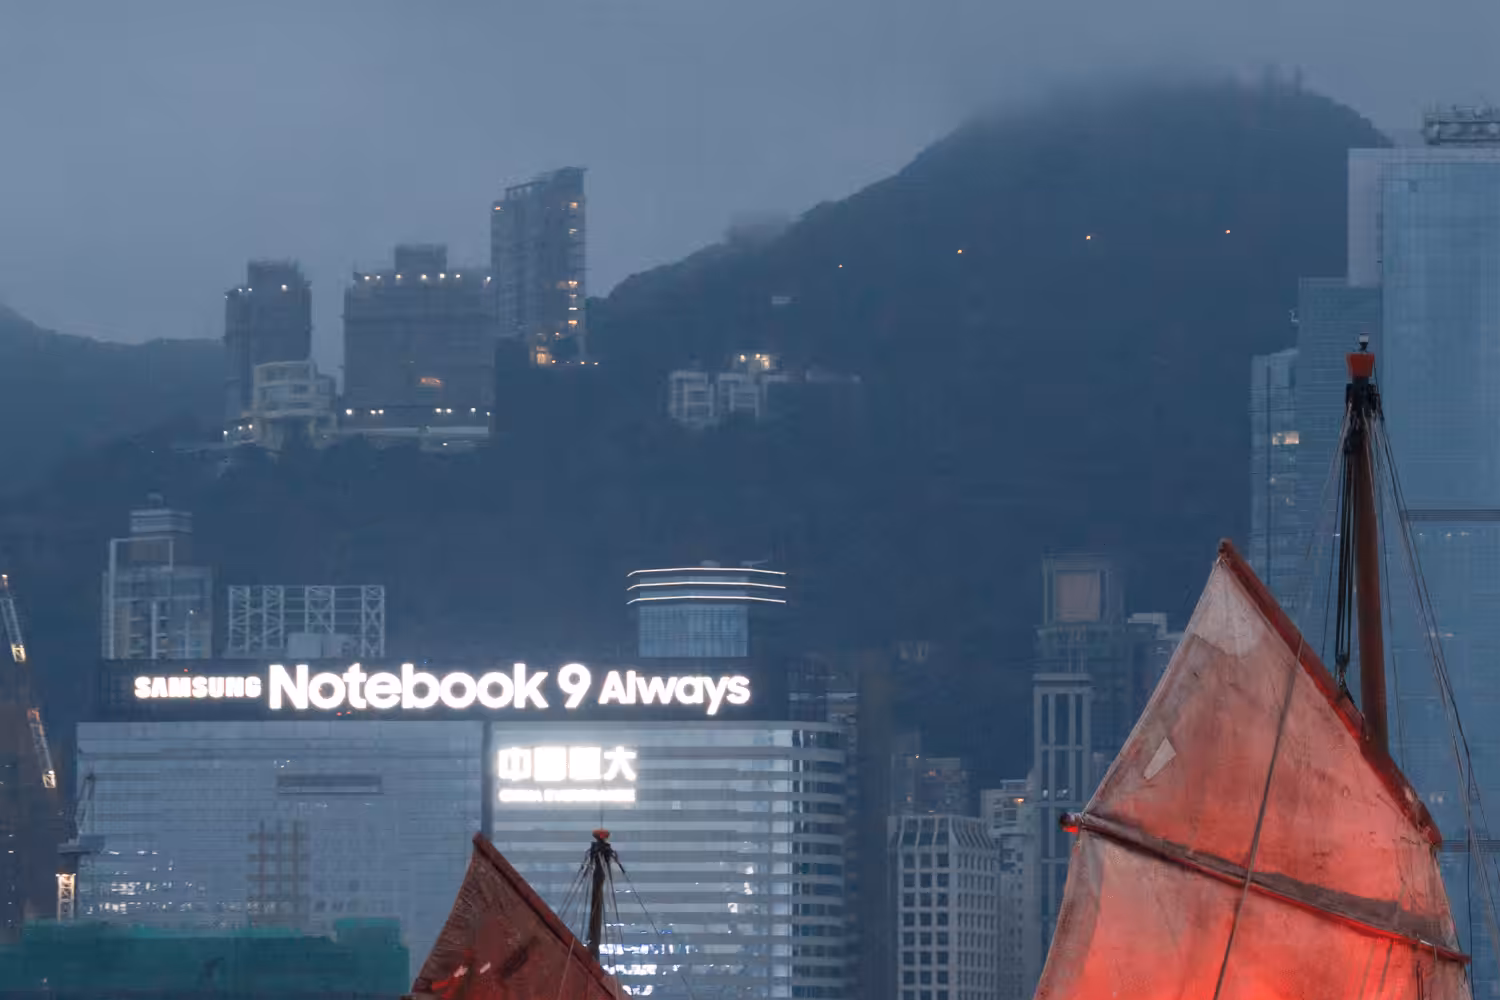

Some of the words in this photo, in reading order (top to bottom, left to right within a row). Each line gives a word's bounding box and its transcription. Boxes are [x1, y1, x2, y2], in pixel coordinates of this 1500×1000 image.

[134, 676, 262, 698] SAMSUNG
[268, 662, 549, 710] Notebook
[557, 663, 592, 709] 9
[598, 670, 751, 715] Always
[498, 745, 637, 781] 中大
